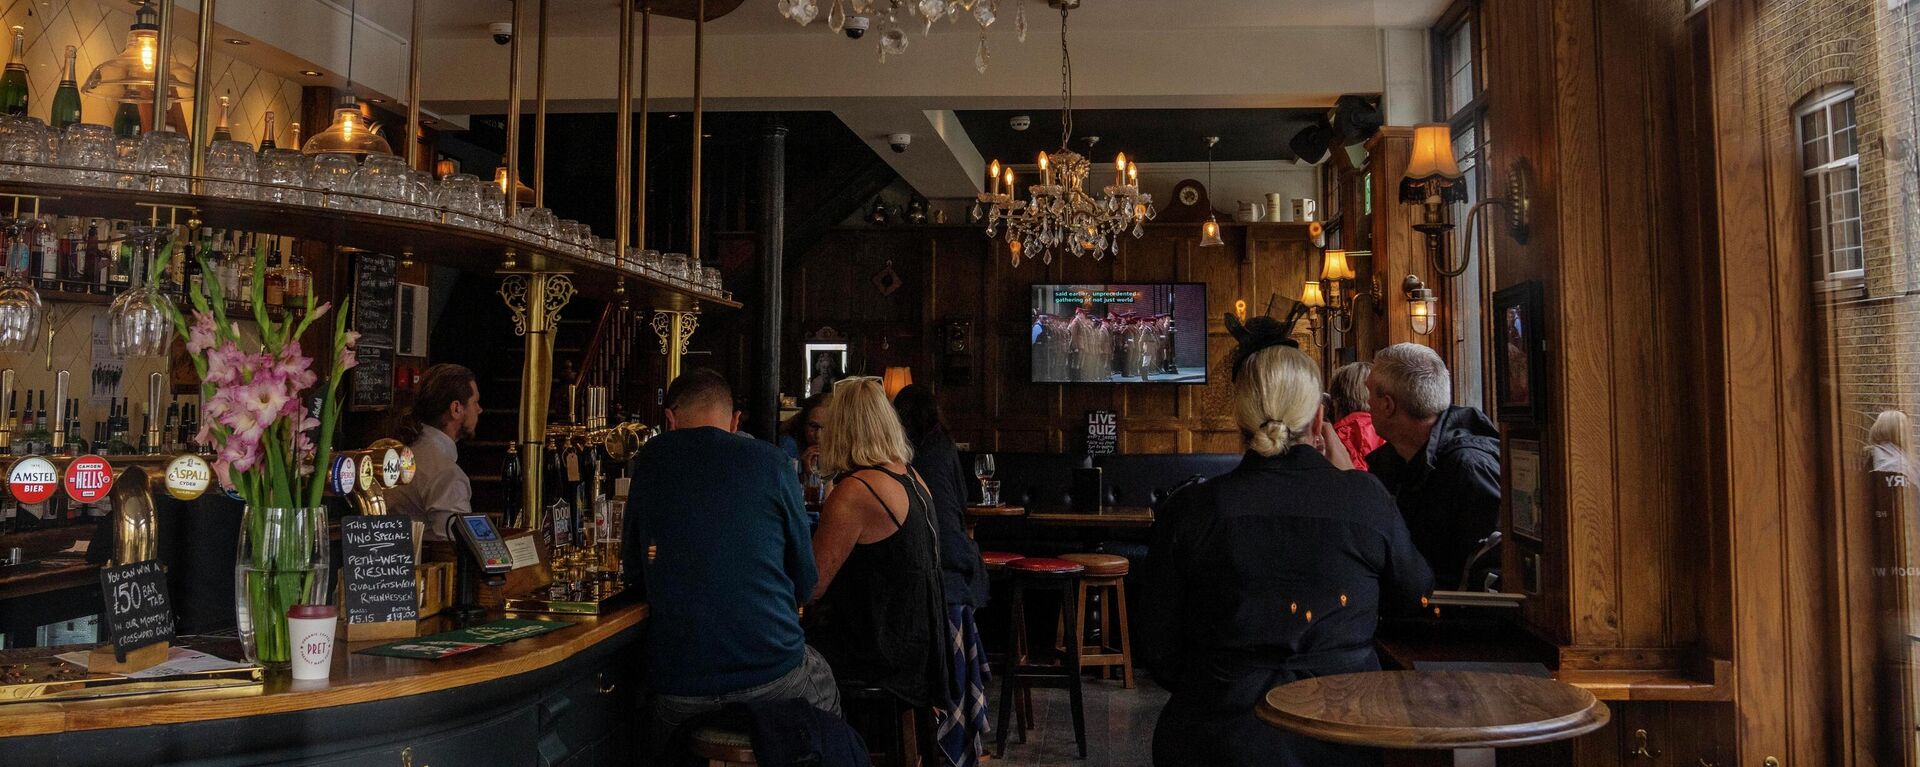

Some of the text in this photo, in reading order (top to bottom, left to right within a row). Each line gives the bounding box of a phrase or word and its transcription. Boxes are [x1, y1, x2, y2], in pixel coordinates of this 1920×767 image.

[1088, 413, 1116, 424] LIVE
[1088, 424, 1117, 436] QUIZ
[14, 472, 54, 482] AMSTEL
[76, 471, 104, 489] HELLS
[173, 467, 208, 481] ASPALL
[24, 485, 44, 493] BIER
[374, 531, 410, 542] SPECIAL:
[349, 554, 413, 566] PETH-WETZ
[108, 563, 161, 583] YOU CAN WIN A
[354, 565, 410, 580] RIESLING
[113, 582, 158, 615] £50 BAR
[147, 593, 165, 607] TAB
[126, 618, 140, 629] OUR
[349, 610, 416, 625] £5.15 £19.00
[119, 629, 154, 646] CROSSWORD
[307, 642, 327, 655] PRET
